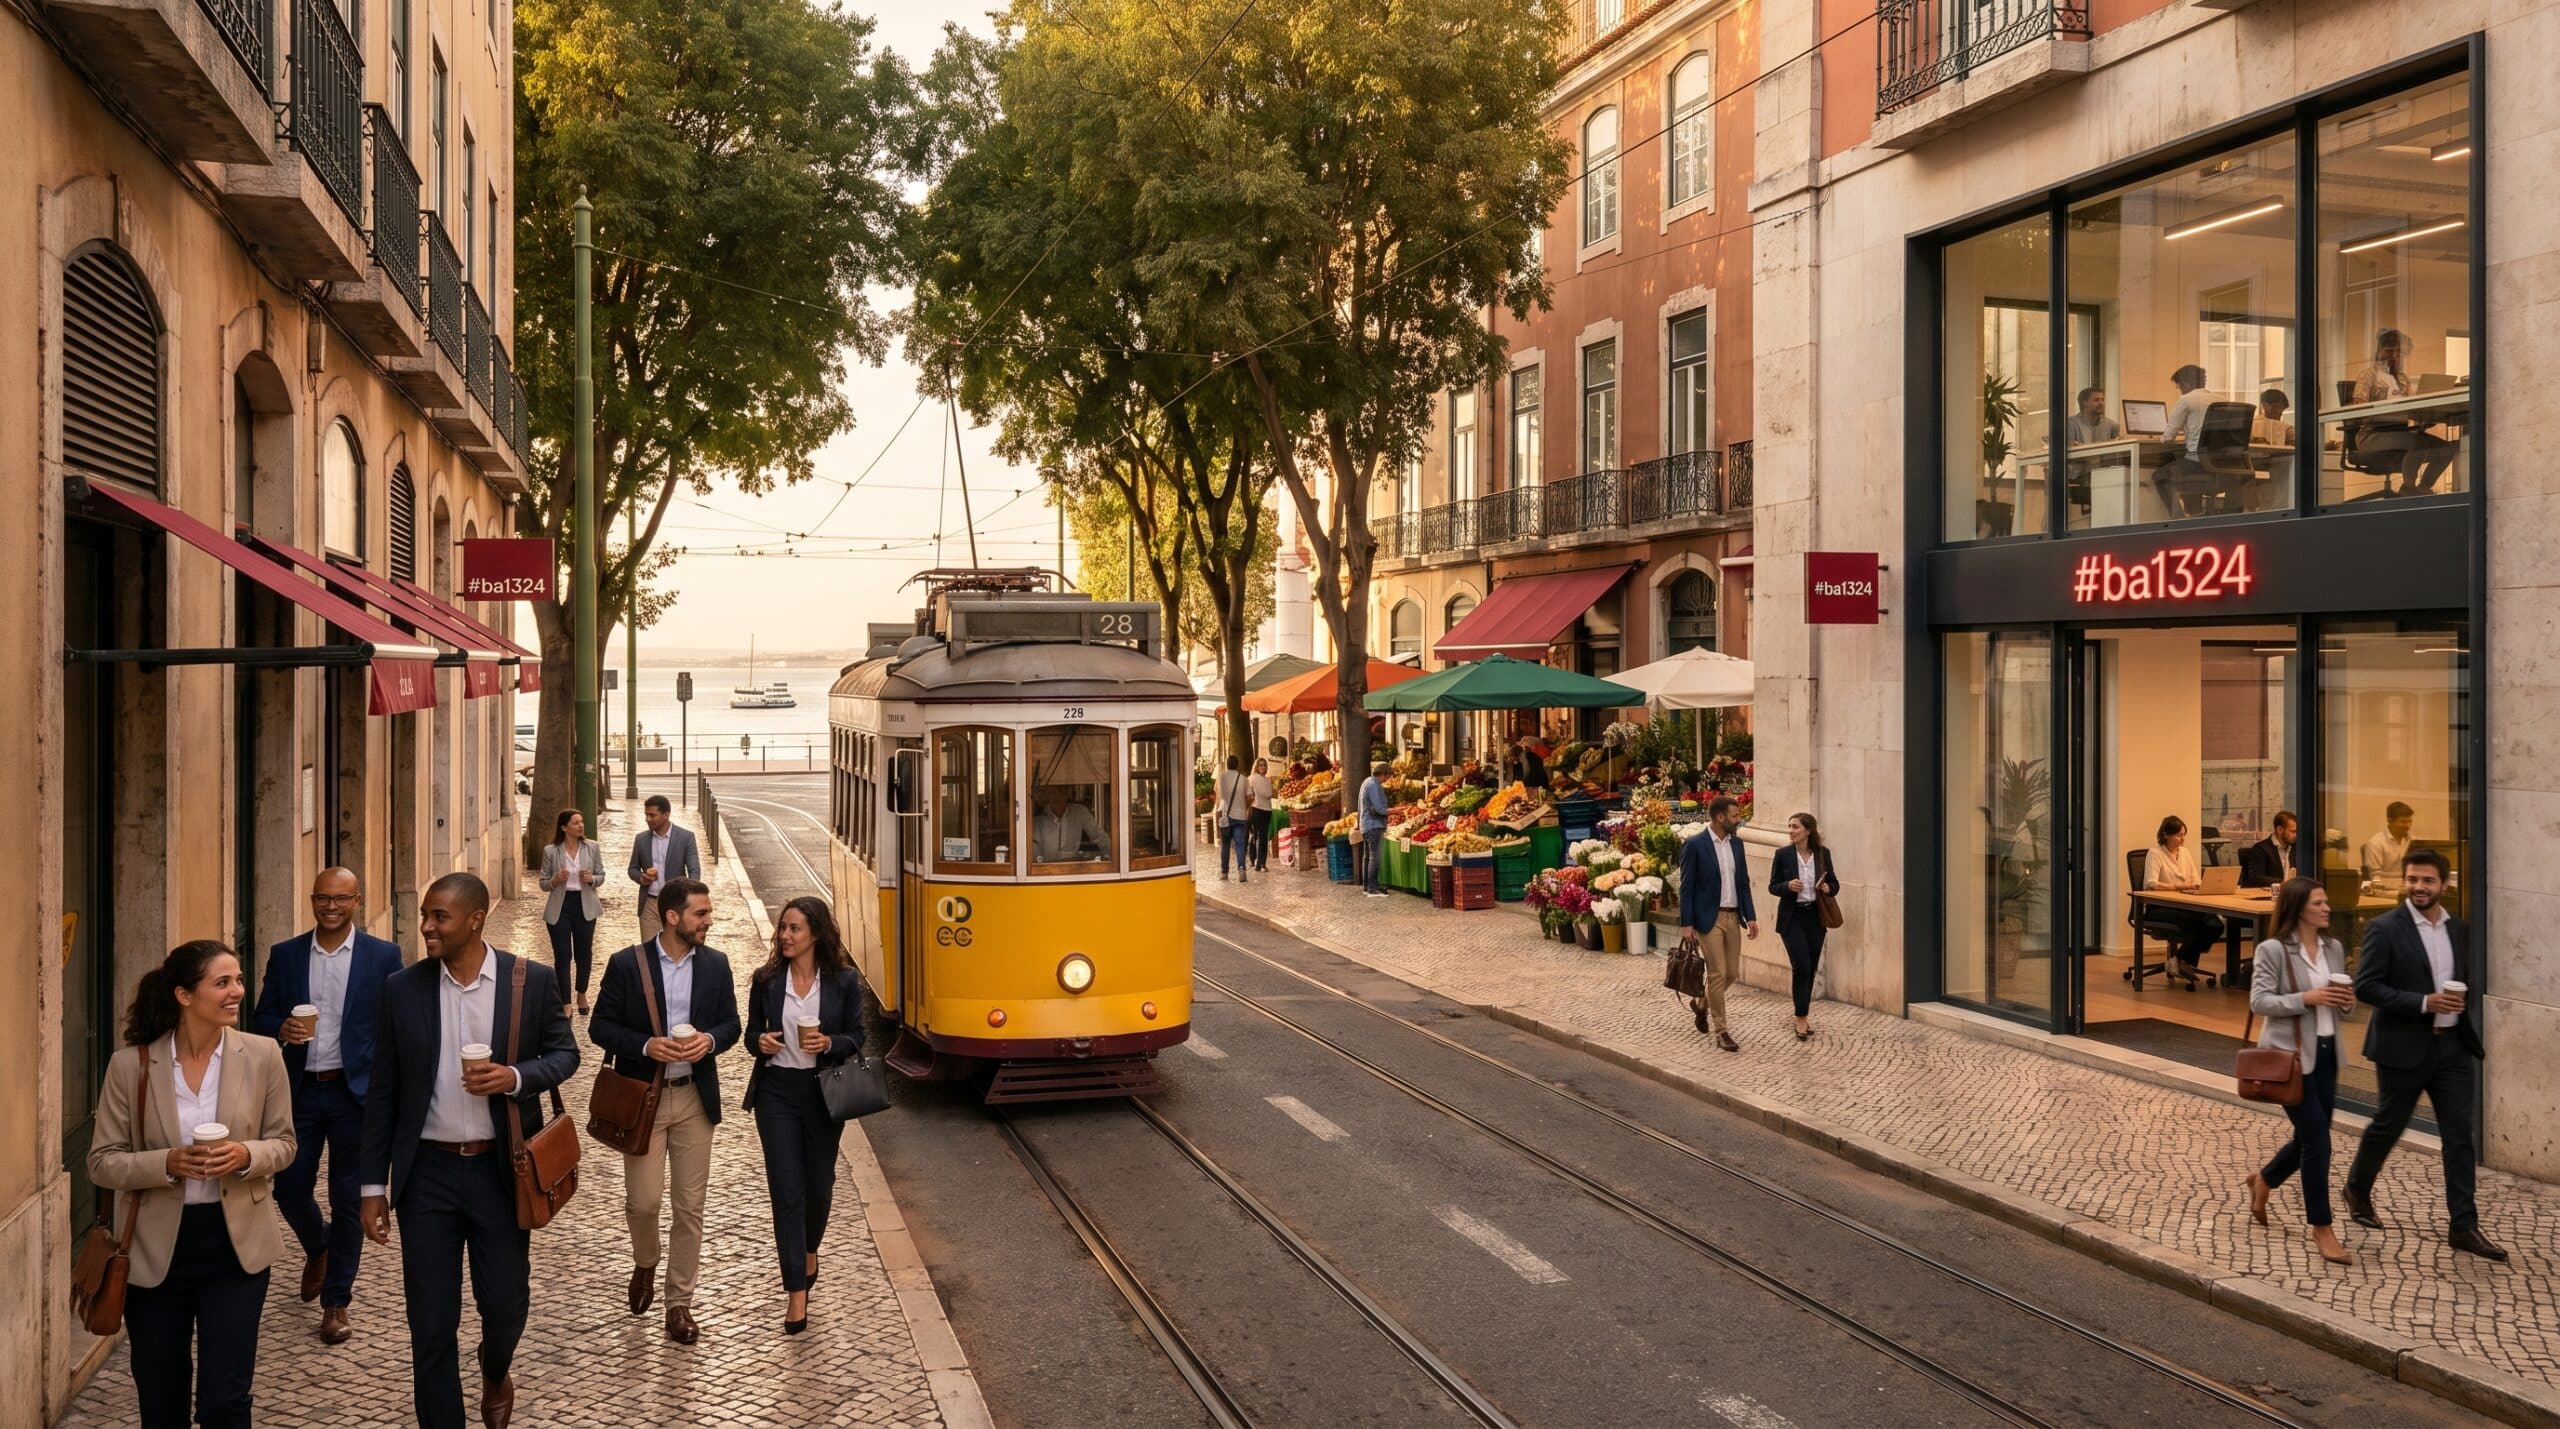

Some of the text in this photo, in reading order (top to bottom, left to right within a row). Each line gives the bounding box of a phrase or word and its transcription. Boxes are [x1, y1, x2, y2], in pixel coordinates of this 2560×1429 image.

[2073, 543, 2253, 603] #ba1324
[467, 577, 546, 594] #ba1324
[1814, 580, 1873, 597] #ba1324
[1099, 613, 1133, 636] 28
[1063, 706, 1085, 719] 228
